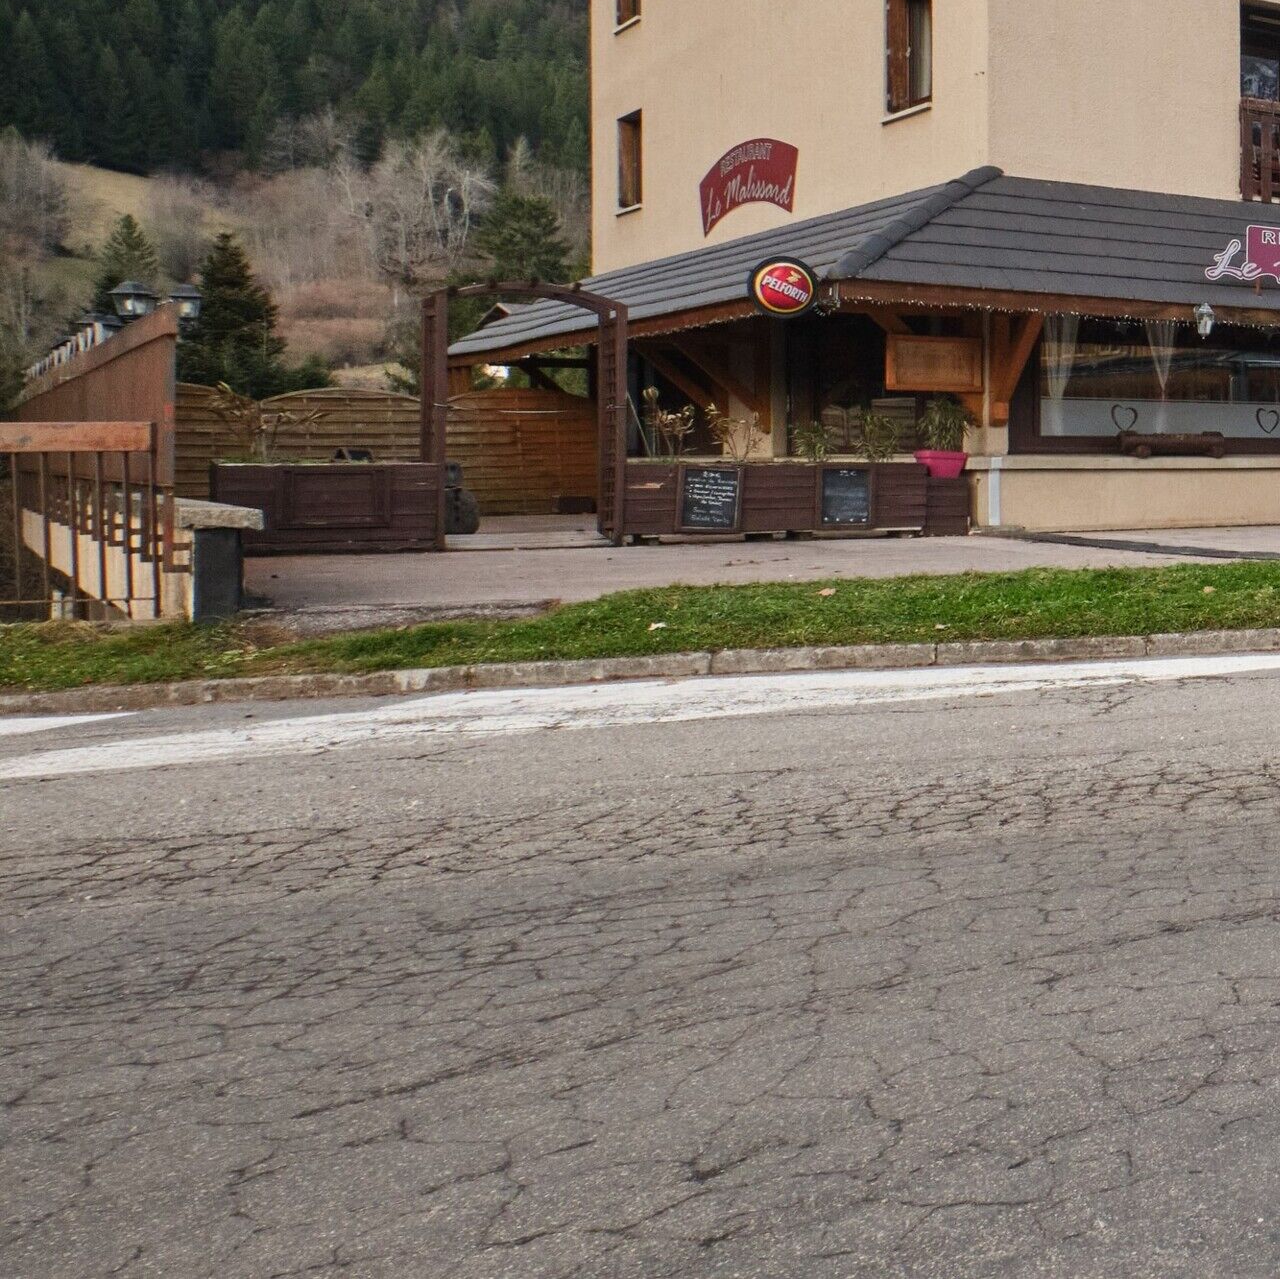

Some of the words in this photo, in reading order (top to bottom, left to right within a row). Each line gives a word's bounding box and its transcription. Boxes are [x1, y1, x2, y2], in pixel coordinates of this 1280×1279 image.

[720, 143, 772, 177] RESTAURANT
[706, 187, 722, 232] Le
[1205, 239, 1262, 280] Le
[761, 274, 810, 303] PELFORTH
